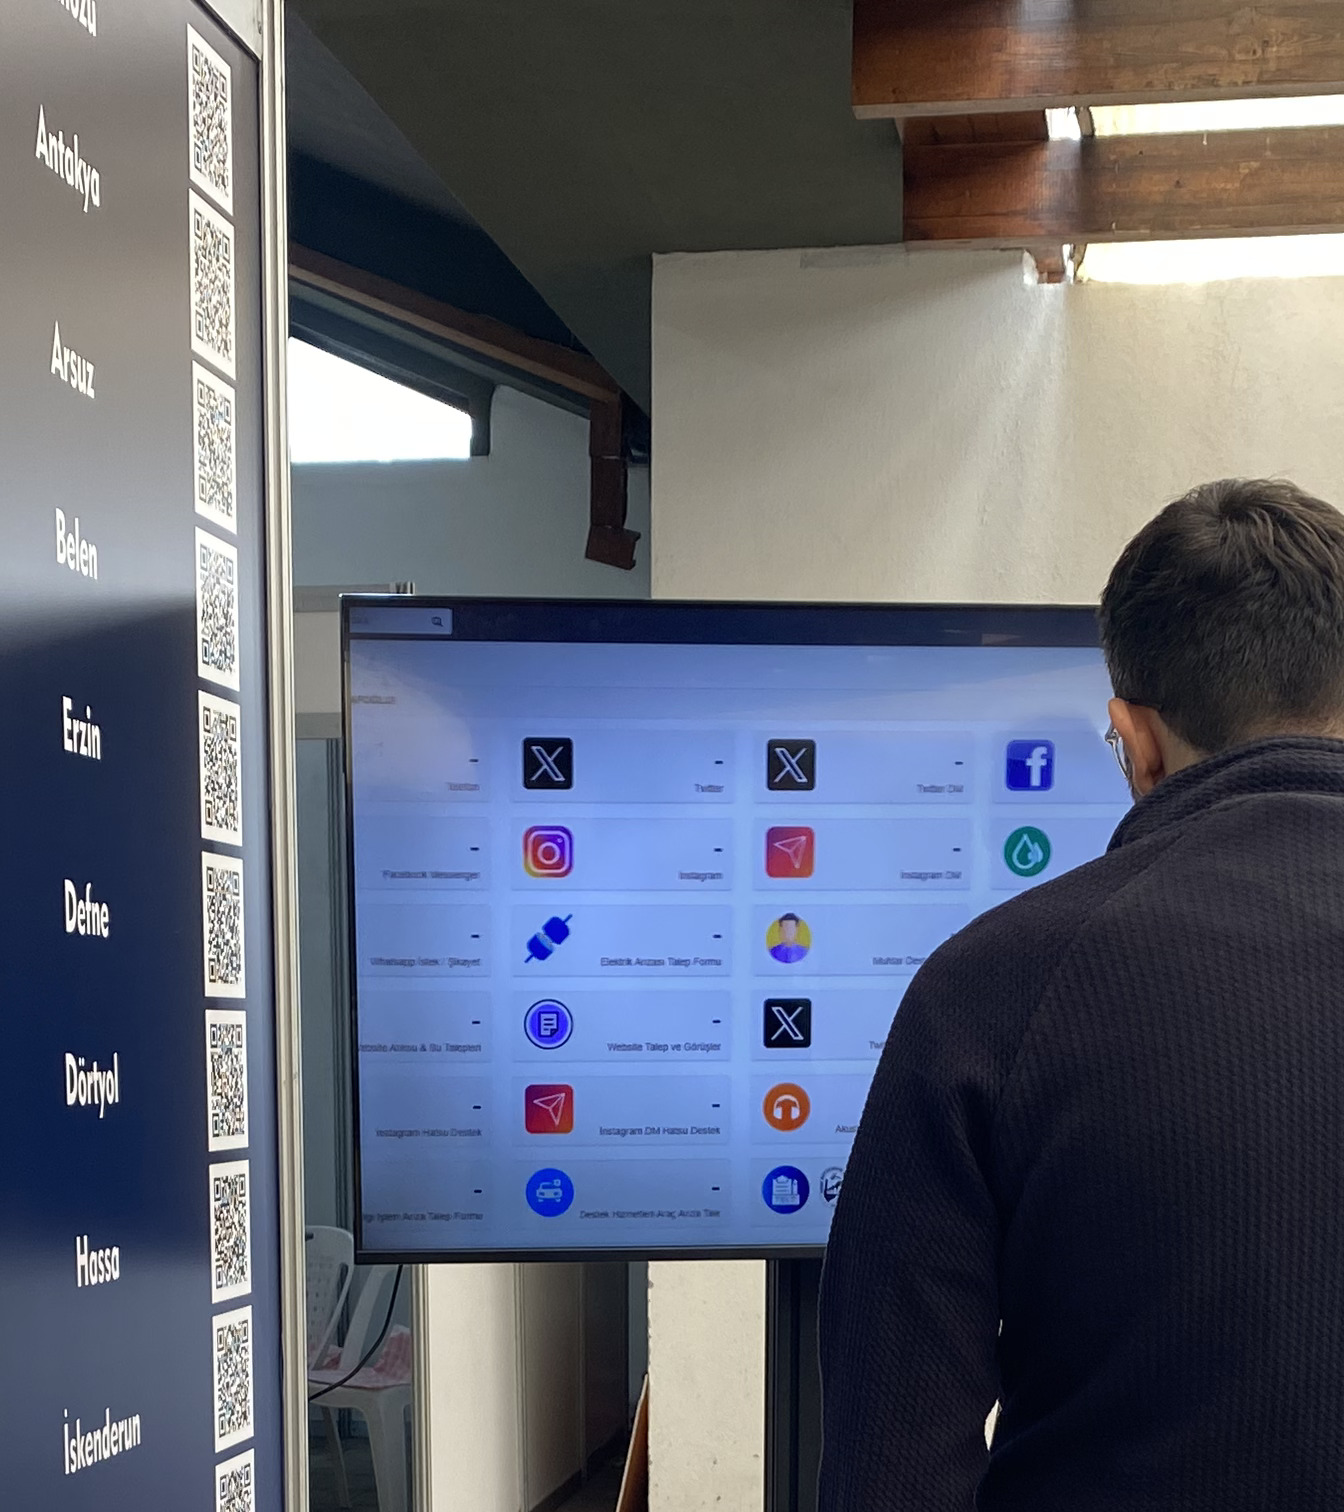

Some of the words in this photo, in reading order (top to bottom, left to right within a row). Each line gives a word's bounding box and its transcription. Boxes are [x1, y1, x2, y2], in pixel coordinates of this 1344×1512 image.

[35, 104, 100, 213] Antakya
[51, 321, 95, 399] Arsuz
[55, 507, 99, 580] Belen
[62, 695, 101, 760] Erzin
[64, 878, 110, 938] Defne
[645, 1042, 669, 1053] Talep
[64, 1052, 119, 1119] Dörtyol
[599, 1126, 643, 1138] Instagram
[76, 1235, 120, 1287] Hassa
[64, 1407, 141, 1475] İskenderun
